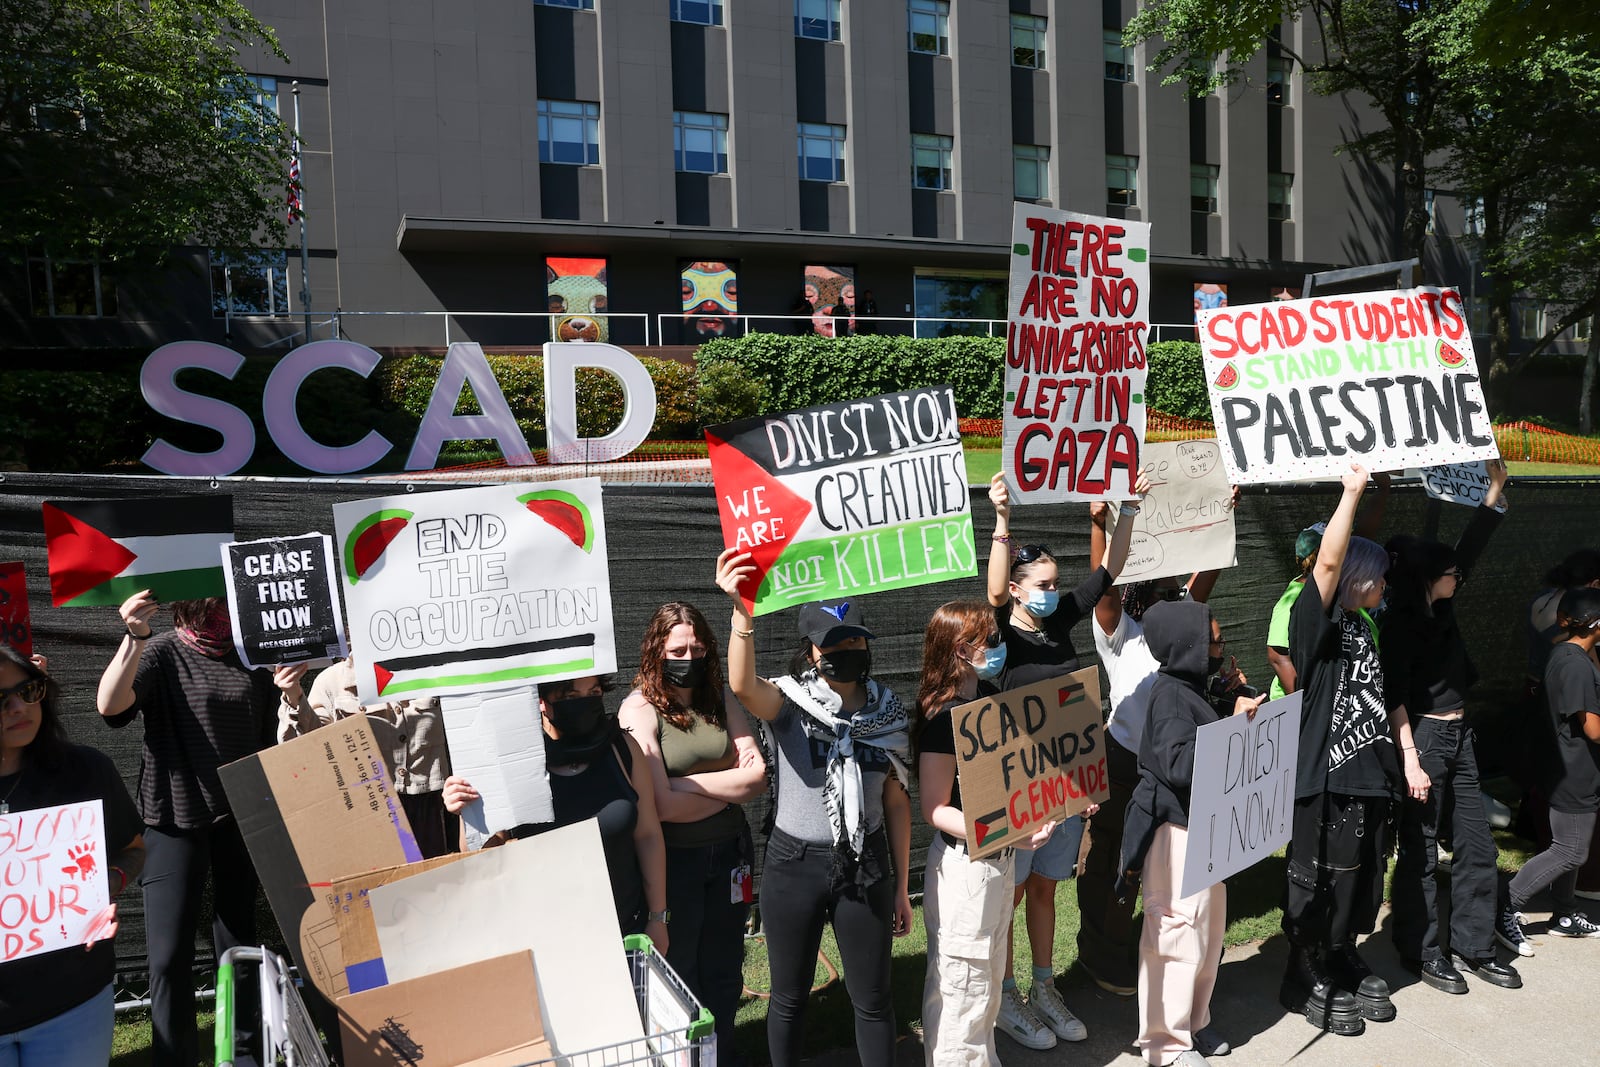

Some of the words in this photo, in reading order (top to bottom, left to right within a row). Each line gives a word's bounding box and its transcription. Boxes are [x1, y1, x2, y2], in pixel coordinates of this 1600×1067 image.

[1026, 217, 1125, 278] THERE
[1019, 274, 1078, 324] ARE
[1090, 277, 1138, 319] NO
[1007, 321, 1147, 375] UNIVERSITIES
[1207, 305, 1307, 359] SCAD
[1310, 290, 1464, 343] STUDENTS
[1245, 347, 1341, 390] STAND
[1345, 339, 1429, 373] WITH
[140, 340, 656, 476] SCAD
[1013, 375, 1091, 423] LEFT
[1222, 373, 1492, 473] PALESTINE
[765, 402, 874, 469] DIVEST
[880, 388, 960, 450] NOW
[1014, 422, 1139, 495] GAZA
[1143, 461, 1169, 481] ee
[725, 486, 771, 519] WE
[815, 451, 965, 532] CREATIVES
[1144, 494, 1230, 531] Palestine
[416, 513, 506, 558] END
[736, 517, 786, 550] ARE
[830, 519, 976, 590] KILLERS
[244, 549, 314, 577] CEASE
[418, 552, 509, 598] THE
[773, 555, 825, 590] NOT
[257, 579, 308, 604] FIRE
[261, 606, 311, 632] NOW
[369, 587, 599, 651] OCCUPATION
[1351, 659, 1373, 684] 19
[323, 741, 335, 761] Blanc
[959, 695, 1046, 762] SCAD
[1224, 711, 1287, 795] DIVEST
[333, 764, 345, 787] Blanco
[1001, 723, 1099, 792] FUNDS
[343, 791, 354, 811] White
[1009, 757, 1107, 830] GENOCIDE
[0, 853, 51, 889] UT
